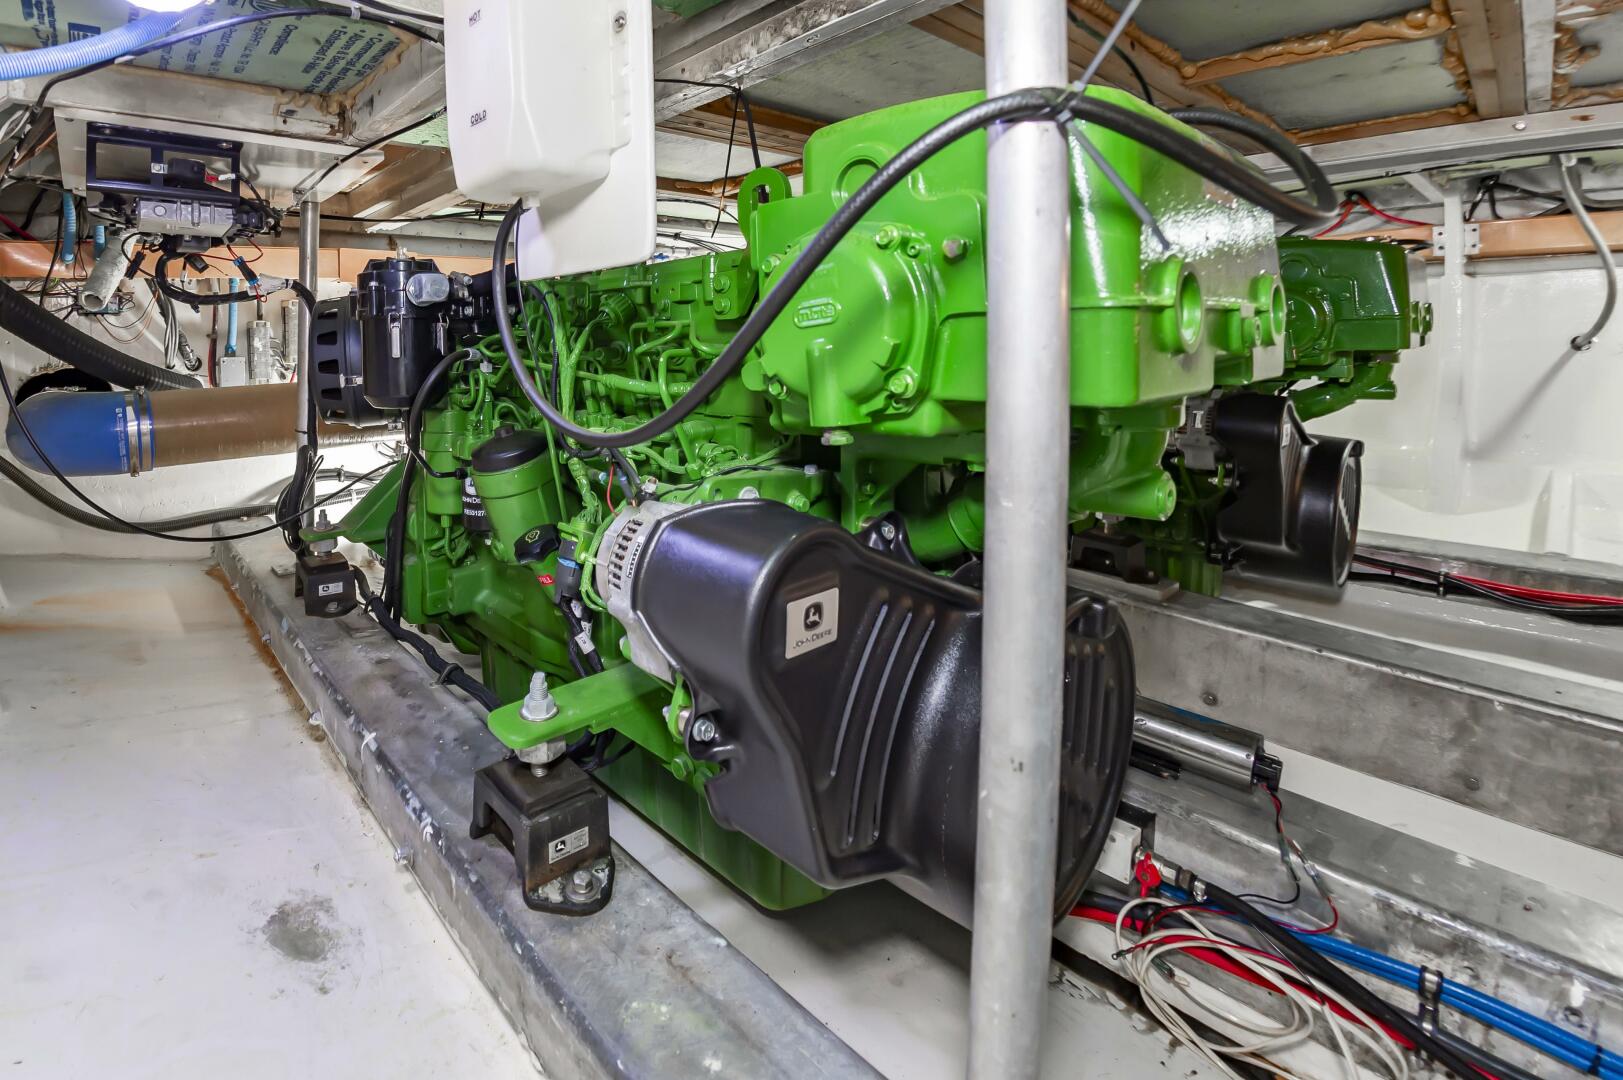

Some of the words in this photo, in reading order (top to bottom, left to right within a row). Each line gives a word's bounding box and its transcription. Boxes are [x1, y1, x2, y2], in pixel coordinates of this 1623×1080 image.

[468, 9, 482, 25] HOT
[315, 29, 347, 56] Enhanced
[343, 32, 365, 51] Above
[325, 51, 345, 70] Below
[346, 37, 383, 66] Commercial
[470, 109, 487, 127] COLD
[811, 629, 833, 642] DEERE
